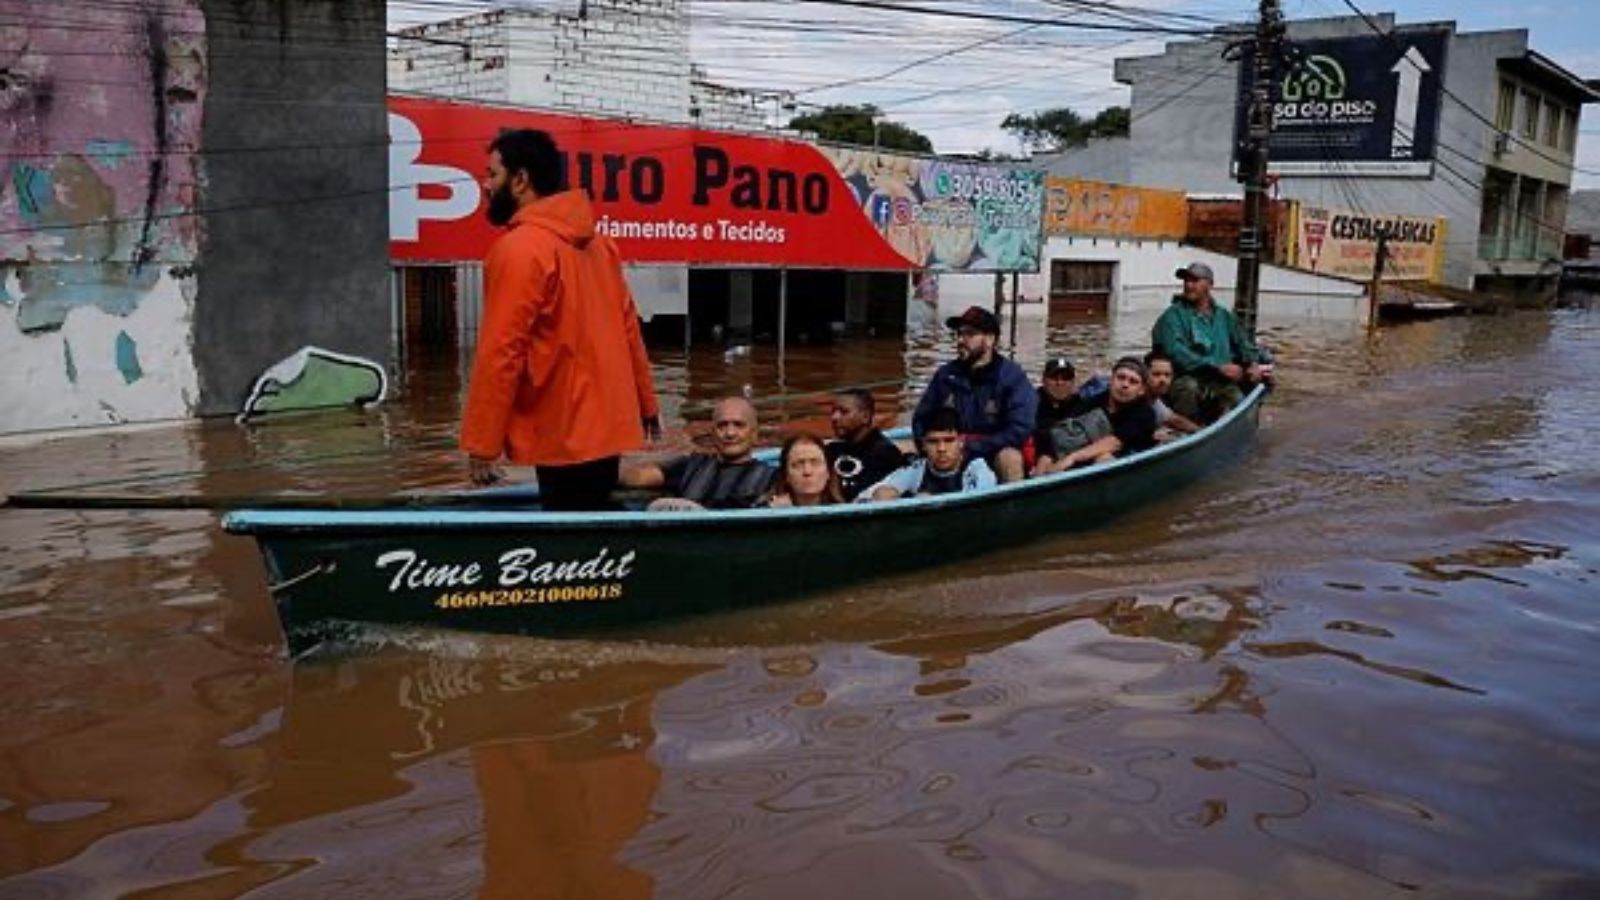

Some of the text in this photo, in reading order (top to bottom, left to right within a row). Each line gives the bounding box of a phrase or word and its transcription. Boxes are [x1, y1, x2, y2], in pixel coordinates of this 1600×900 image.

[1300, 99, 1328, 118] do
[1331, 100, 1377, 119] piso
[559, 145, 830, 215] uro Pano
[595, 215, 786, 243] viamentos e Tecidos
[375, 547, 636, 592] Time Bandit
[433, 583, 623, 609] 466M2021000618
